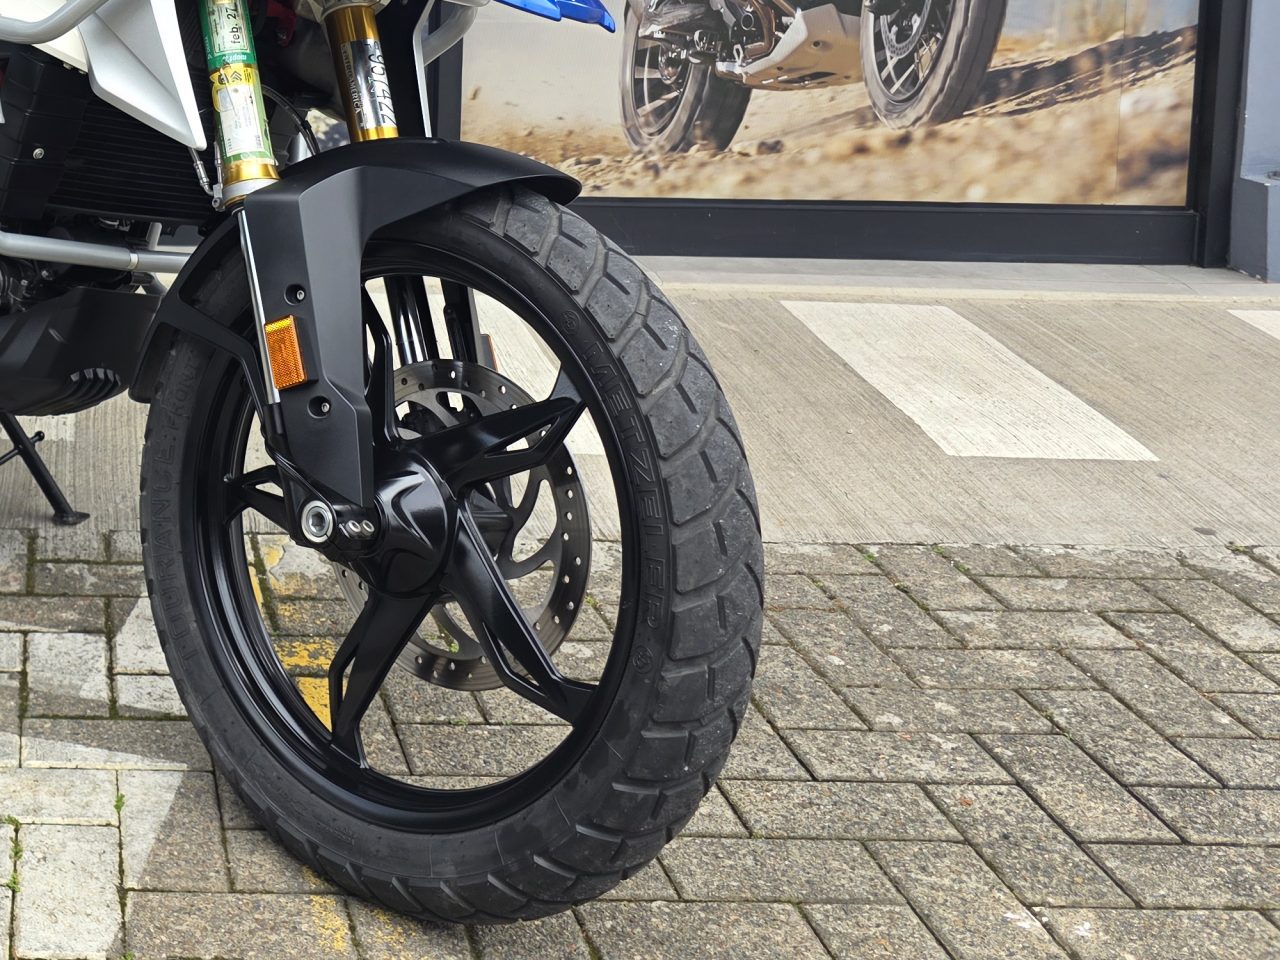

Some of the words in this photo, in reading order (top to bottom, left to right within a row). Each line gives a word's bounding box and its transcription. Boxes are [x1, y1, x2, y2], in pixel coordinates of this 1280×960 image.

[229, 23, 241, 44] feb.
[152, 442, 199, 662] TOURANCE
[583, 341, 665, 628] METZELER
